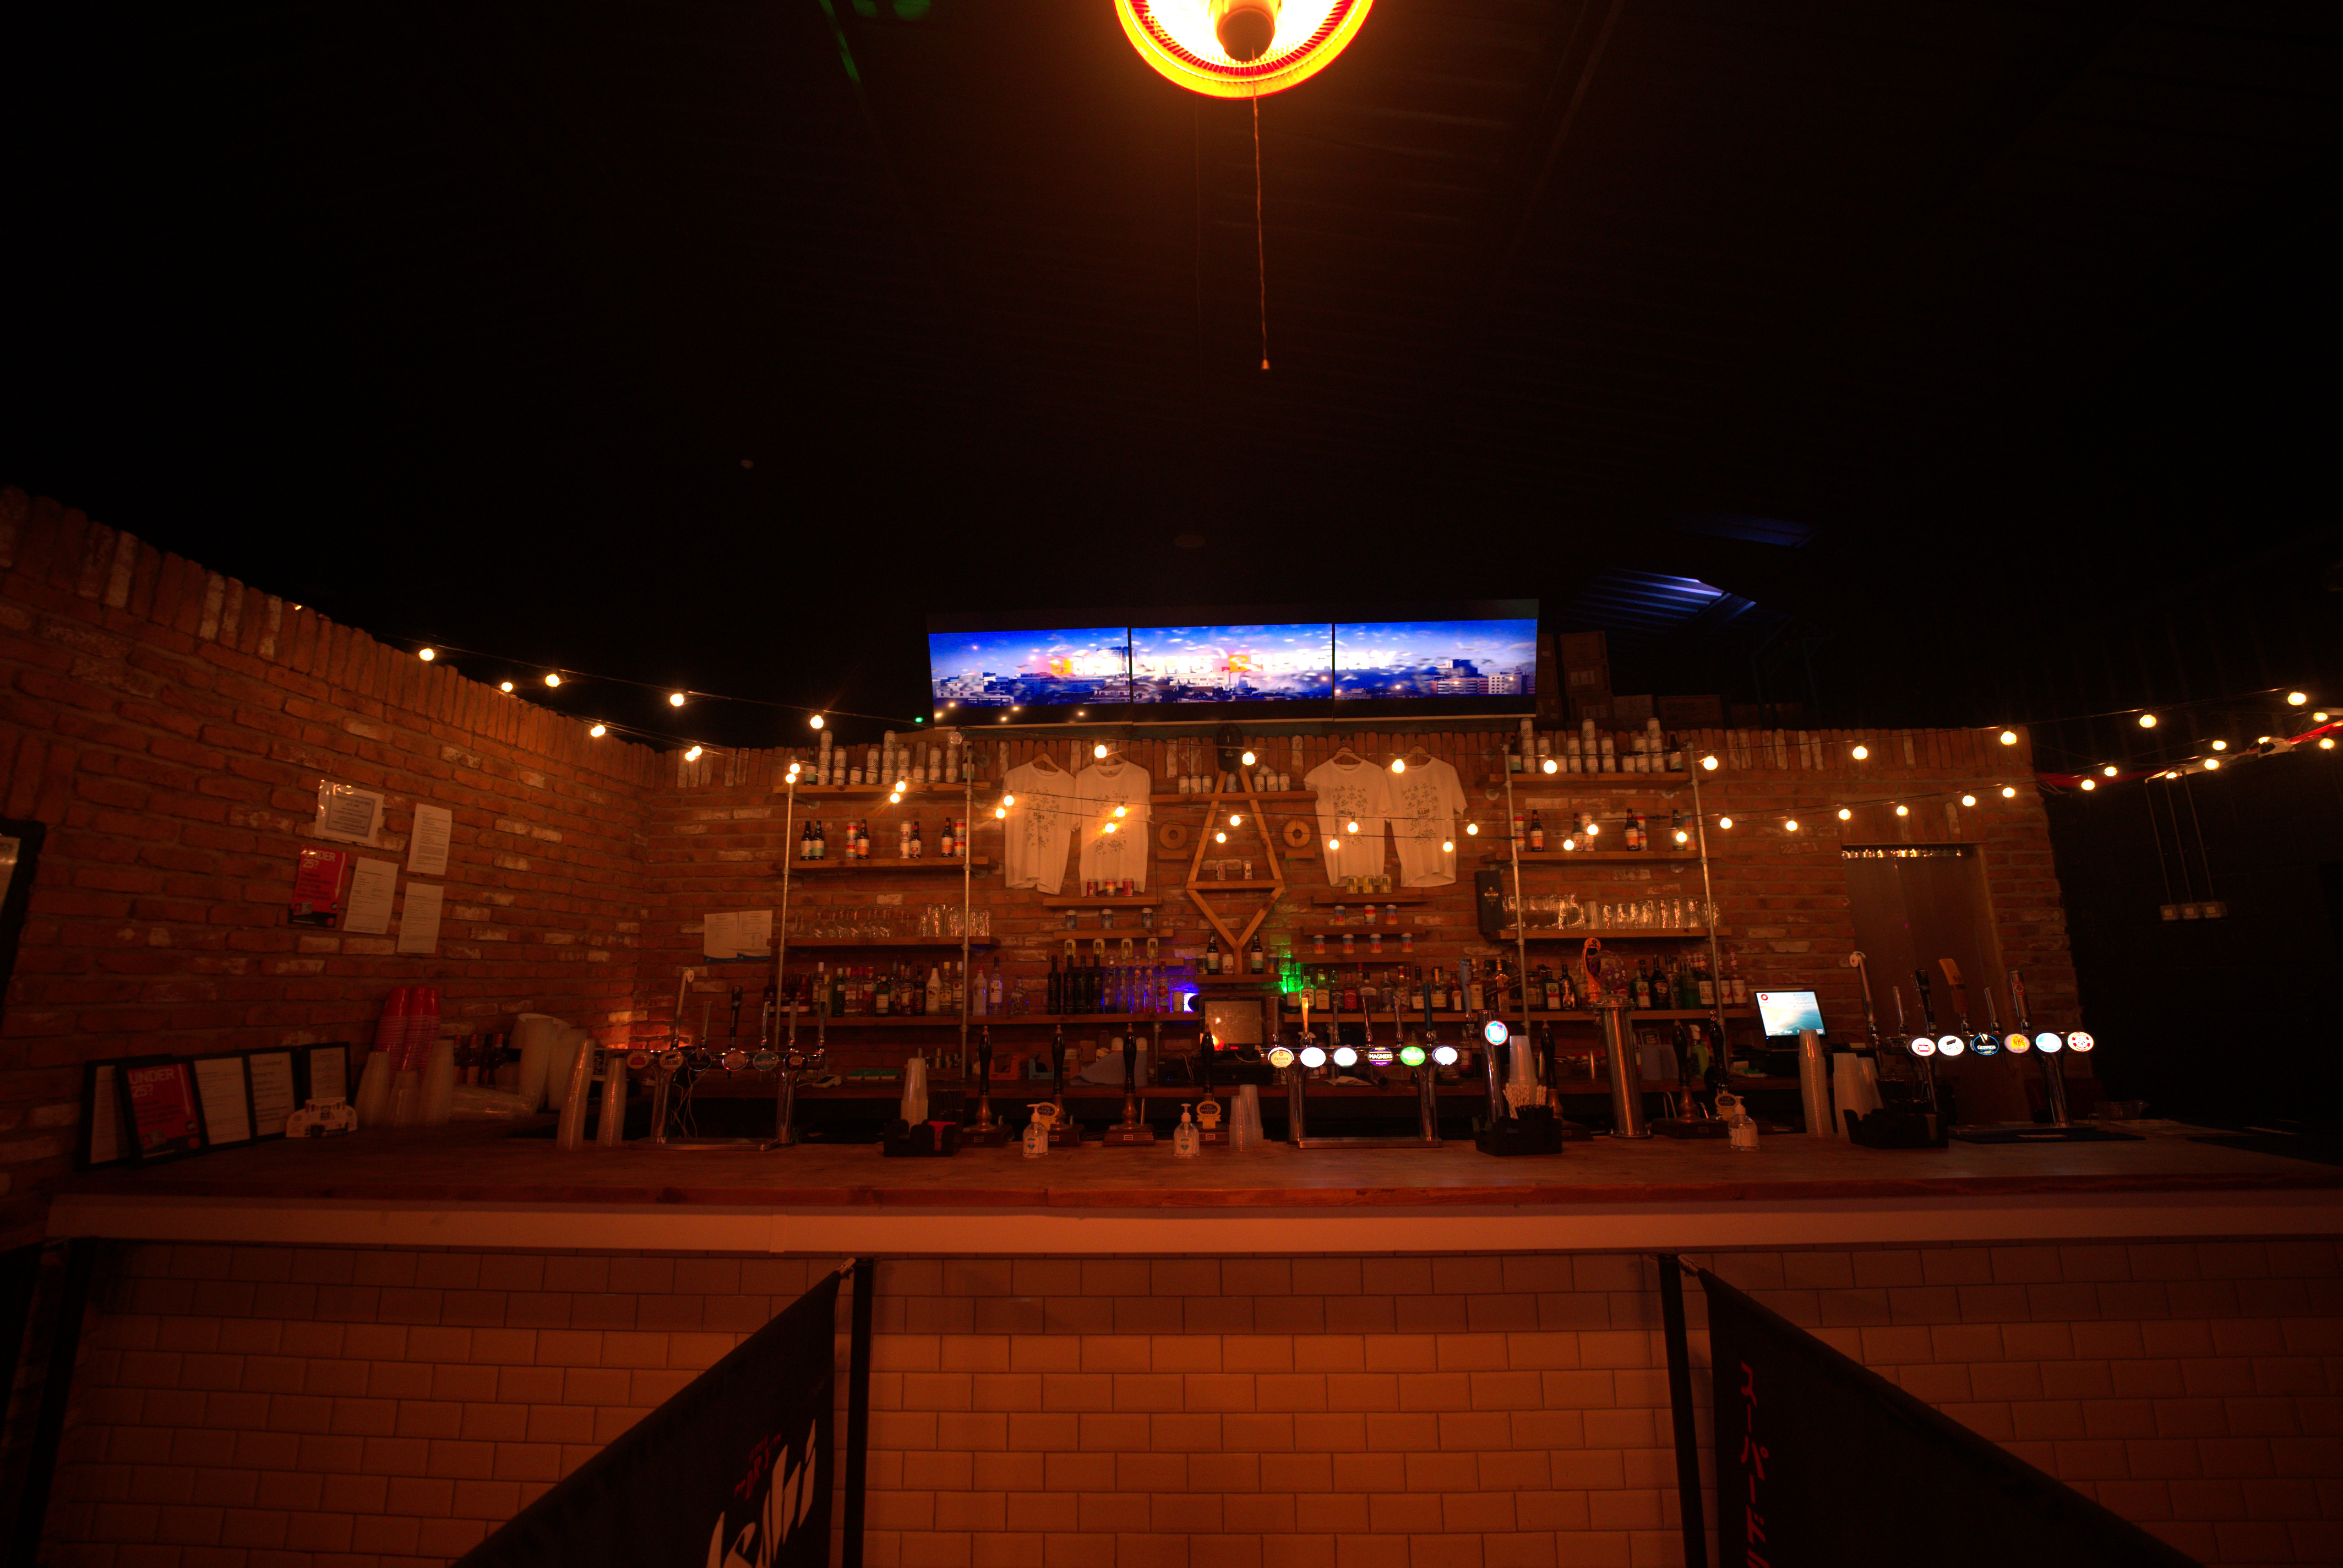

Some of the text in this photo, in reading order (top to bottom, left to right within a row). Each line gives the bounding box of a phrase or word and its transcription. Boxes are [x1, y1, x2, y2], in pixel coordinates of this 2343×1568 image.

[303, 859, 319, 869] 25?
[128, 1068, 175, 1084] UNDER
[130, 1083, 154, 1097] 25?
